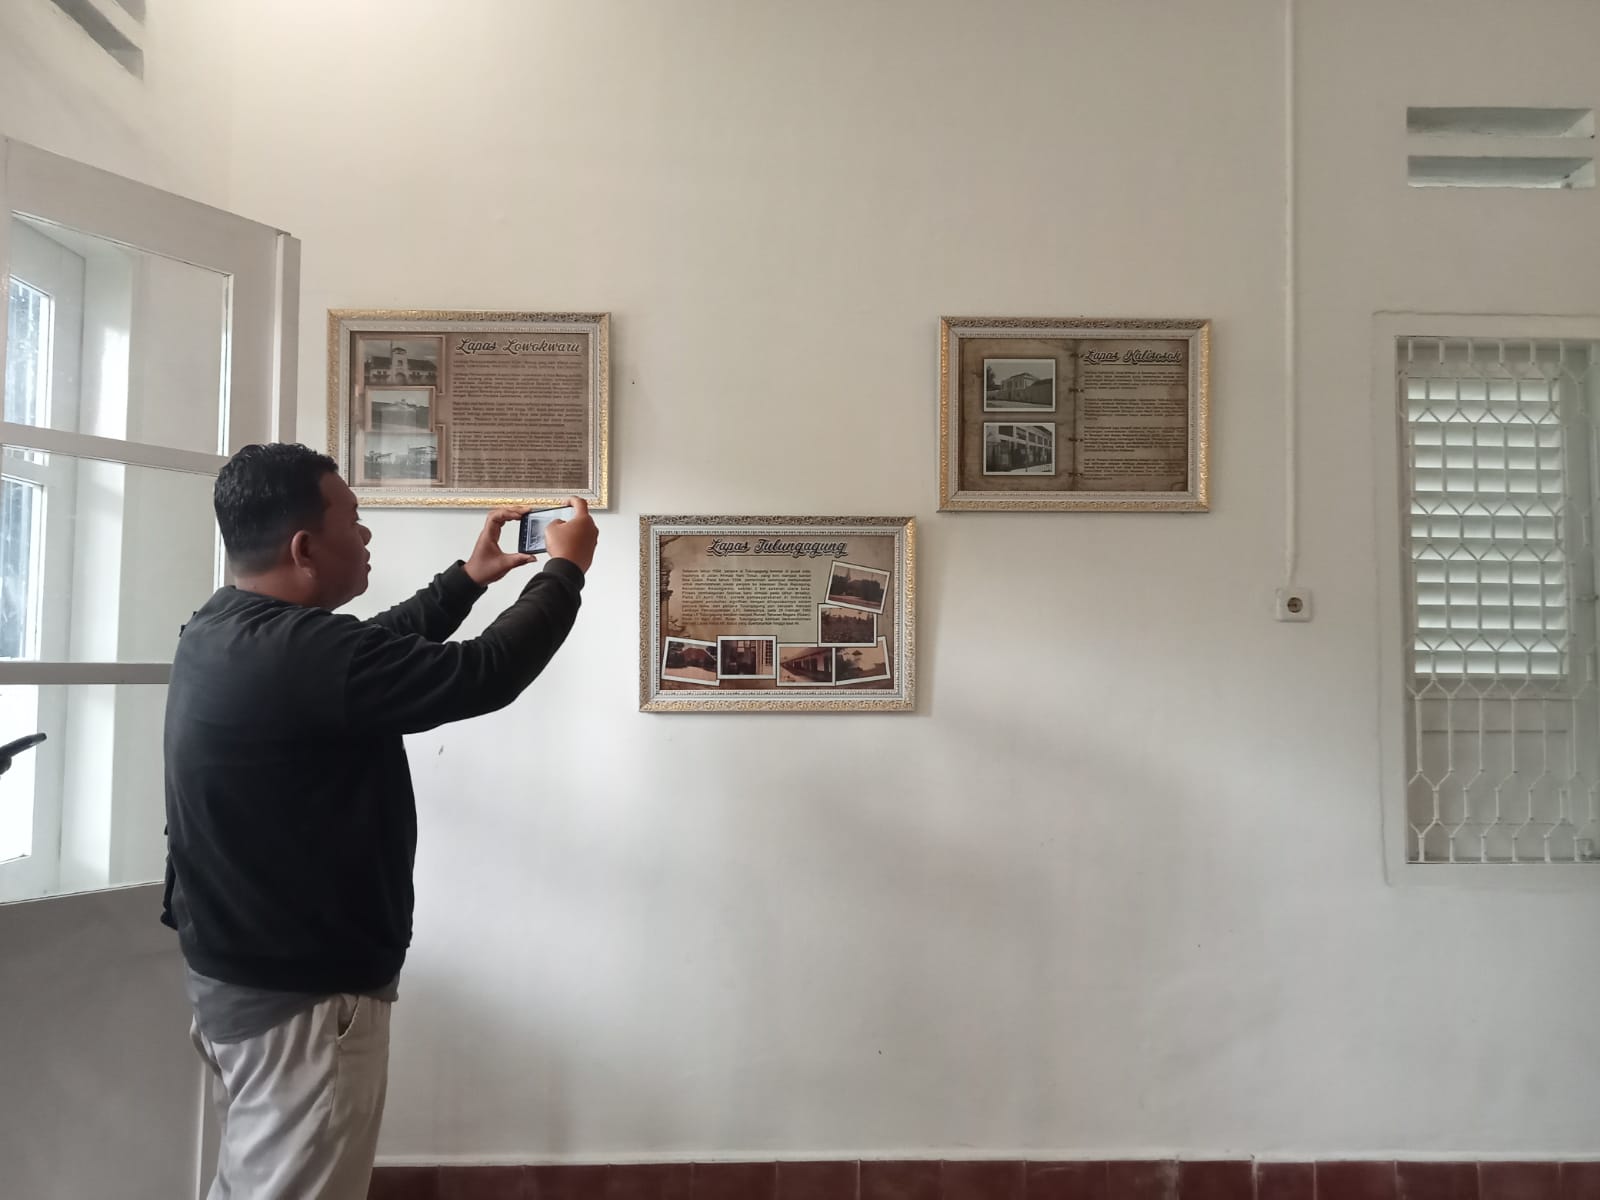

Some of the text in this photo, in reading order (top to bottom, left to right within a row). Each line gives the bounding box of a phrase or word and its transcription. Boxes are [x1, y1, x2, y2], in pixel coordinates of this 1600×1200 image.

[455, 338, 581, 355] Lapas Lowokwaru
[1083, 349, 1183, 365] Lapas Kalisosok
[706, 538, 849, 559] Lapas Tulungagung
